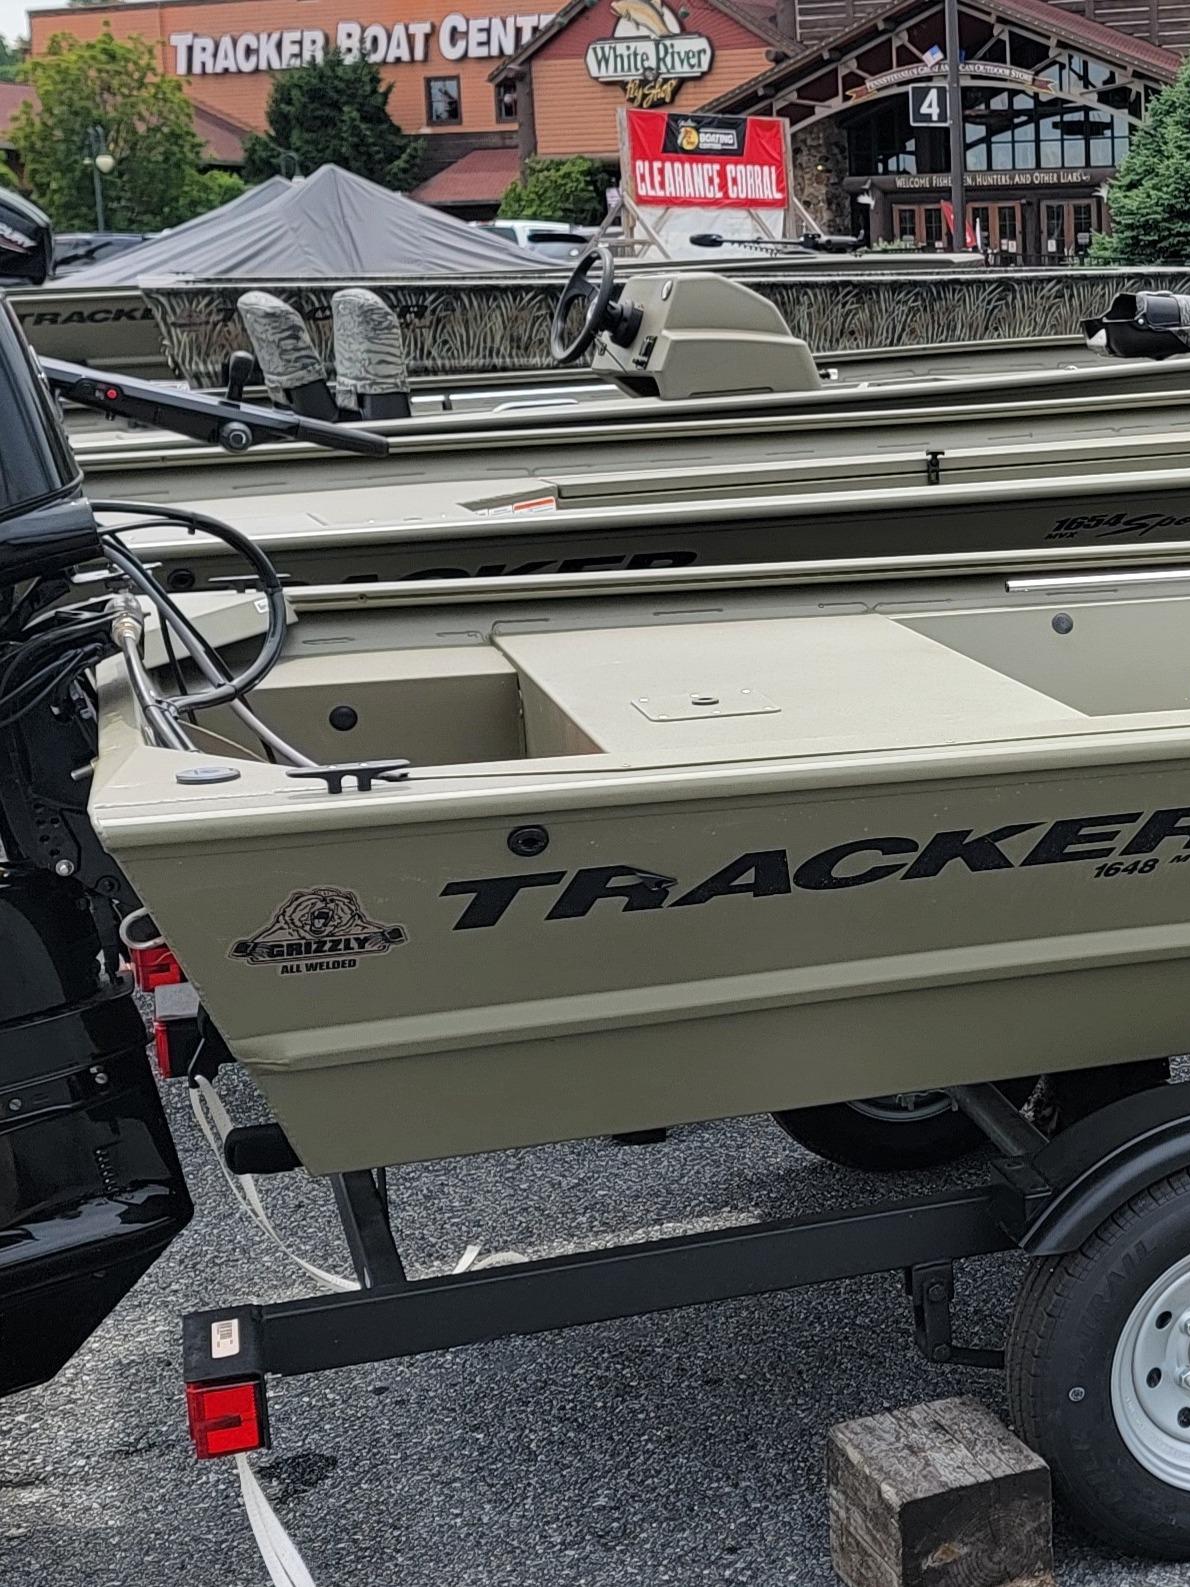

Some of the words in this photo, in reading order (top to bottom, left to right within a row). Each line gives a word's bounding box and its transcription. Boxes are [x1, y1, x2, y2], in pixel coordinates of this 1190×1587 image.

[169, 28, 326, 76] TRACKER
[336, 20, 432, 66] BOAT
[591, 43, 650, 74] White
[654, 39, 707, 74] River
[974, 64, 1009, 75] OUTDOOR
[919, 88, 940, 121] 4
[635, 160, 724, 199] CLEARANCE
[726, 164, 783, 200] CORRAL
[896, 176, 930, 188] WELCOME
[932, 174, 976, 187] FISHEEN,
[1014, 172, 1031, 185] AND
[1033, 172, 1058, 184] OTHER
[1052, 513, 1127, 533] 1654
[1044, 531, 1078, 541] MVX
[1093, 857, 1161, 879] 1648
[267, 936, 370, 958] GRIZZLY
[280, 963, 303, 975] ALL
[305, 958, 358, 972] WELDED
